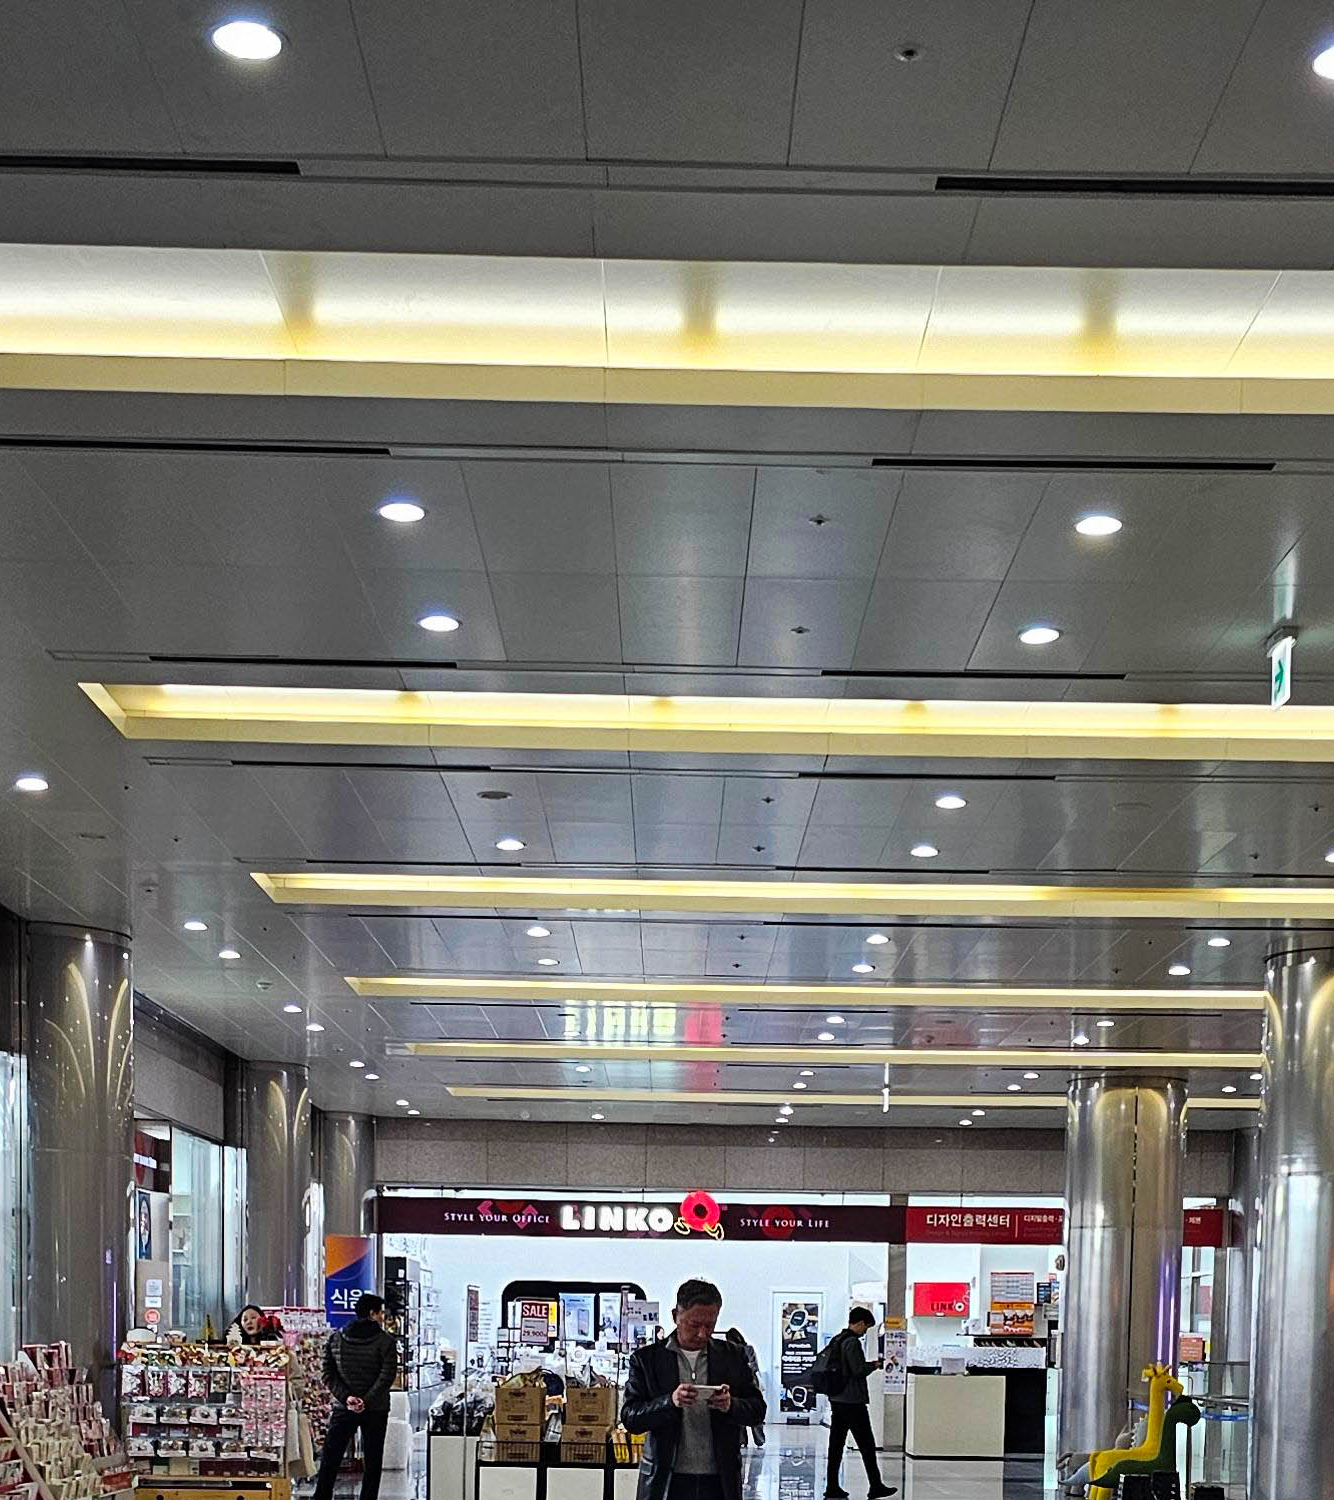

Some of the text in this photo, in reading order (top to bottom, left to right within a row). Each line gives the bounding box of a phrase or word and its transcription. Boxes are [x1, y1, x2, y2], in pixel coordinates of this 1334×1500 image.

[443, 1212, 550, 1224] STYLE YOUR OFFICE
[560, 1204, 675, 1233] LINKO
[739, 1218, 830, 1229] STYLE YOUR LIFE
[925, 1212, 1011, 1229] 디자인출력센터
[330, 1288, 373, 1310] 식음
[522, 1304, 548, 1317] SALE
